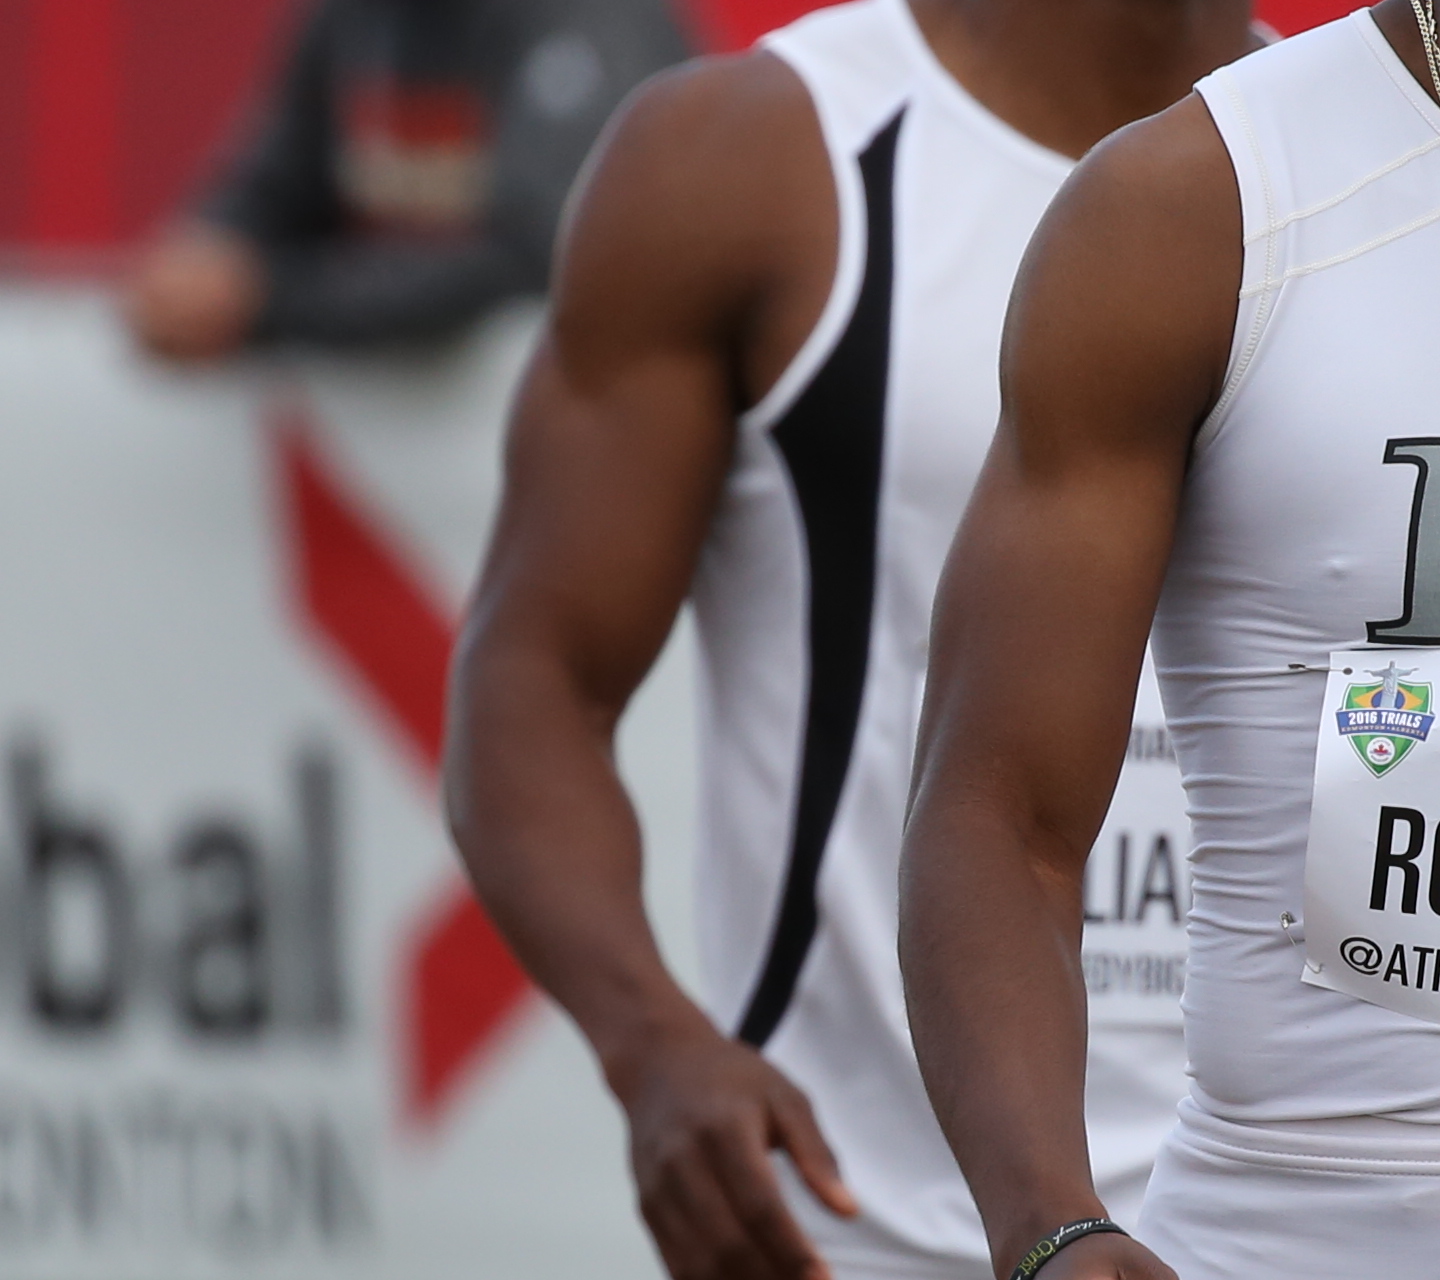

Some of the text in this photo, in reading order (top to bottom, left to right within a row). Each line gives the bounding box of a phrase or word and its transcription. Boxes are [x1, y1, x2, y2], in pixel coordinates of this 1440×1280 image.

[1348, 711, 1423, 728] 2016 TRIALS
[1019, 1239, 1055, 1276] Christ
